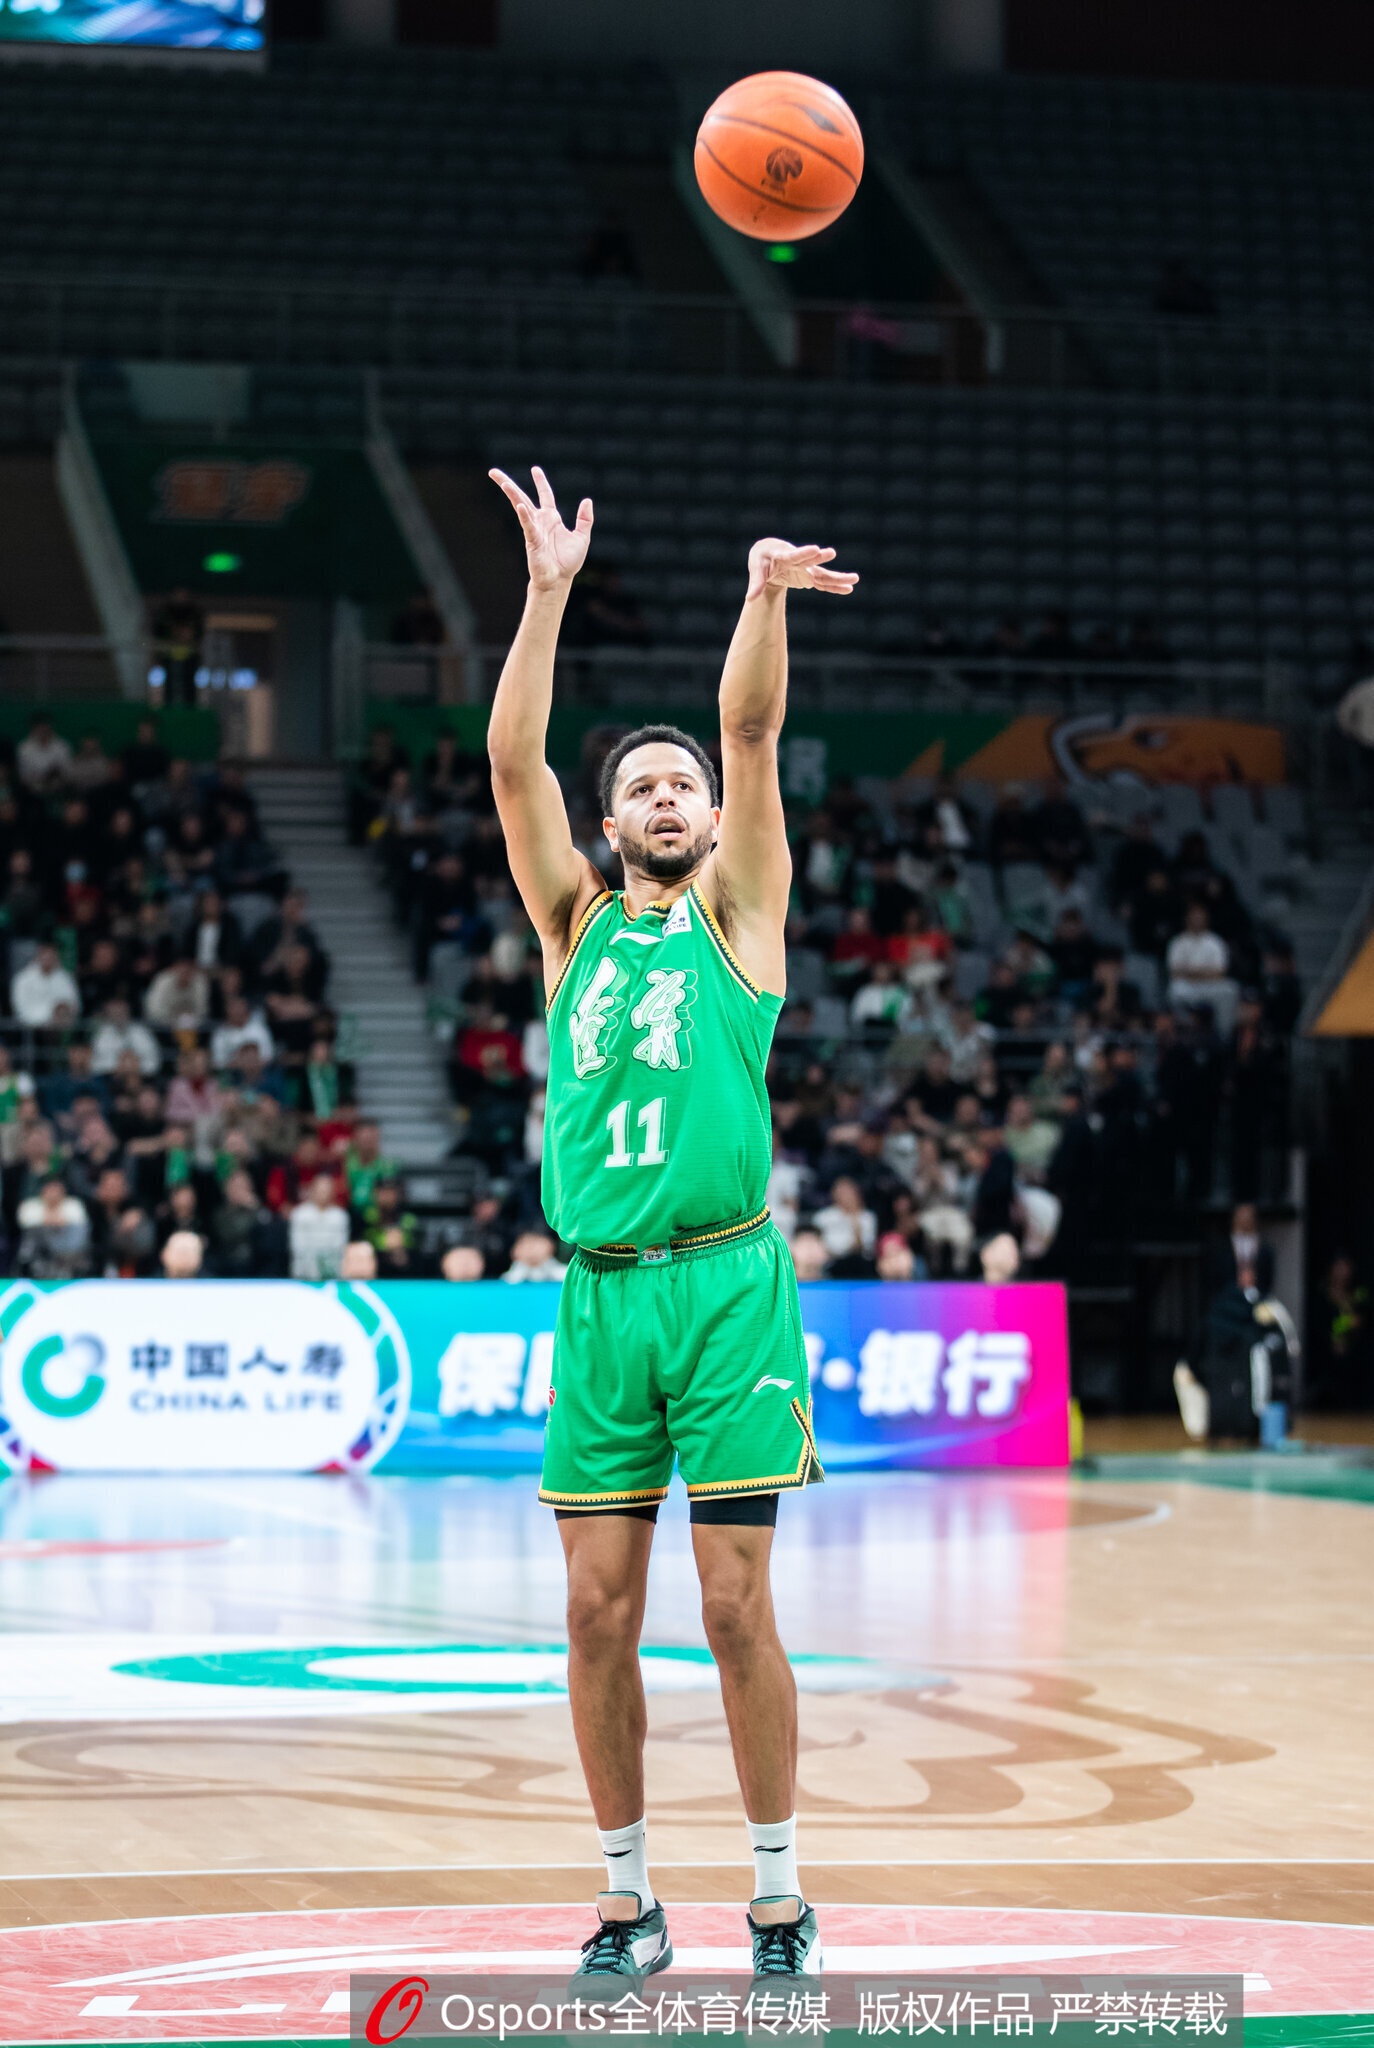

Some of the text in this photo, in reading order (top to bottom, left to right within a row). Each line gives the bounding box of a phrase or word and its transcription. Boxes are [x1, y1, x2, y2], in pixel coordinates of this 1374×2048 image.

[604, 1097, 669, 1168] 11
[130, 1340, 344, 1380] 中国人寿
[438, 1331, 554, 1418] 保
[130, 1390, 342, 1412] CHINA LIFE
